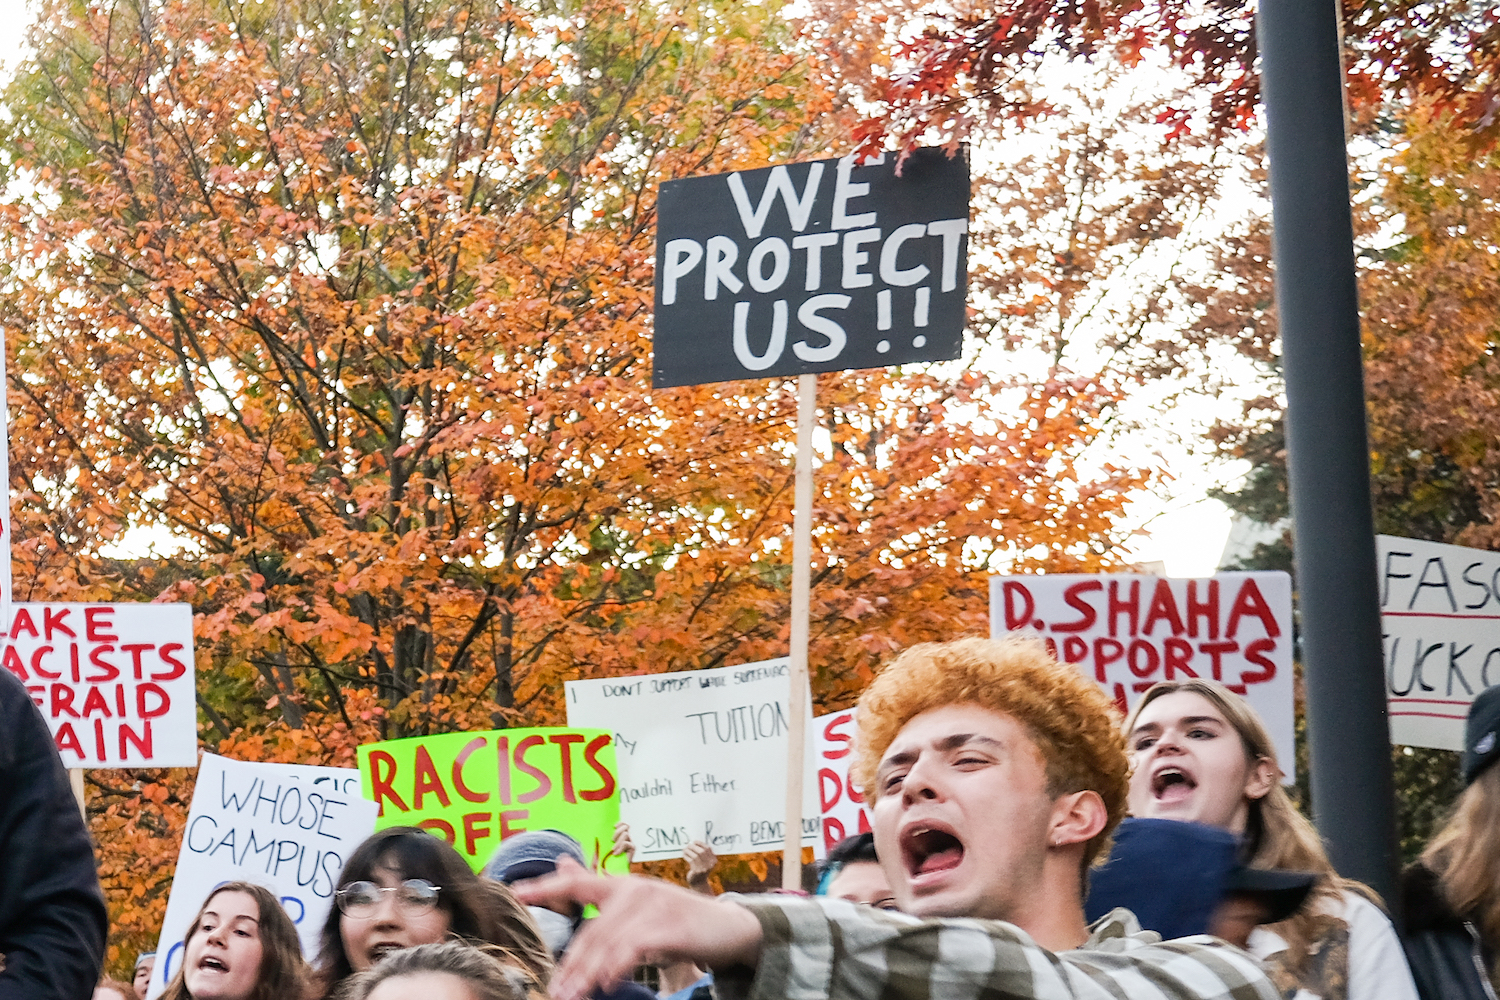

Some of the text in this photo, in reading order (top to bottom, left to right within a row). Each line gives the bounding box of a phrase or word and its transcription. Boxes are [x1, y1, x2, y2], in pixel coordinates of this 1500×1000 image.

[727, 152, 885, 239] WE
[662, 217, 968, 306] PROTECT
[0, 607, 119, 643] AKE
[2, 643, 187, 683] ACISTS
[733, 665, 789, 686] SUPREMAC
[1045, 635, 1277, 684] PPORTS
[1383, 632, 1474, 697] UCK
[26, 682, 171, 720] FRAID
[684, 700, 790, 745] TUITION
[54, 718, 153, 762] AIN
[368, 733, 616, 817] RACISTS
[221, 770, 348, 841] WHOSE
[188, 814, 343, 898] CAMPUS
[416, 809, 530, 856] OFF
[642, 825, 691, 849] SIMS
